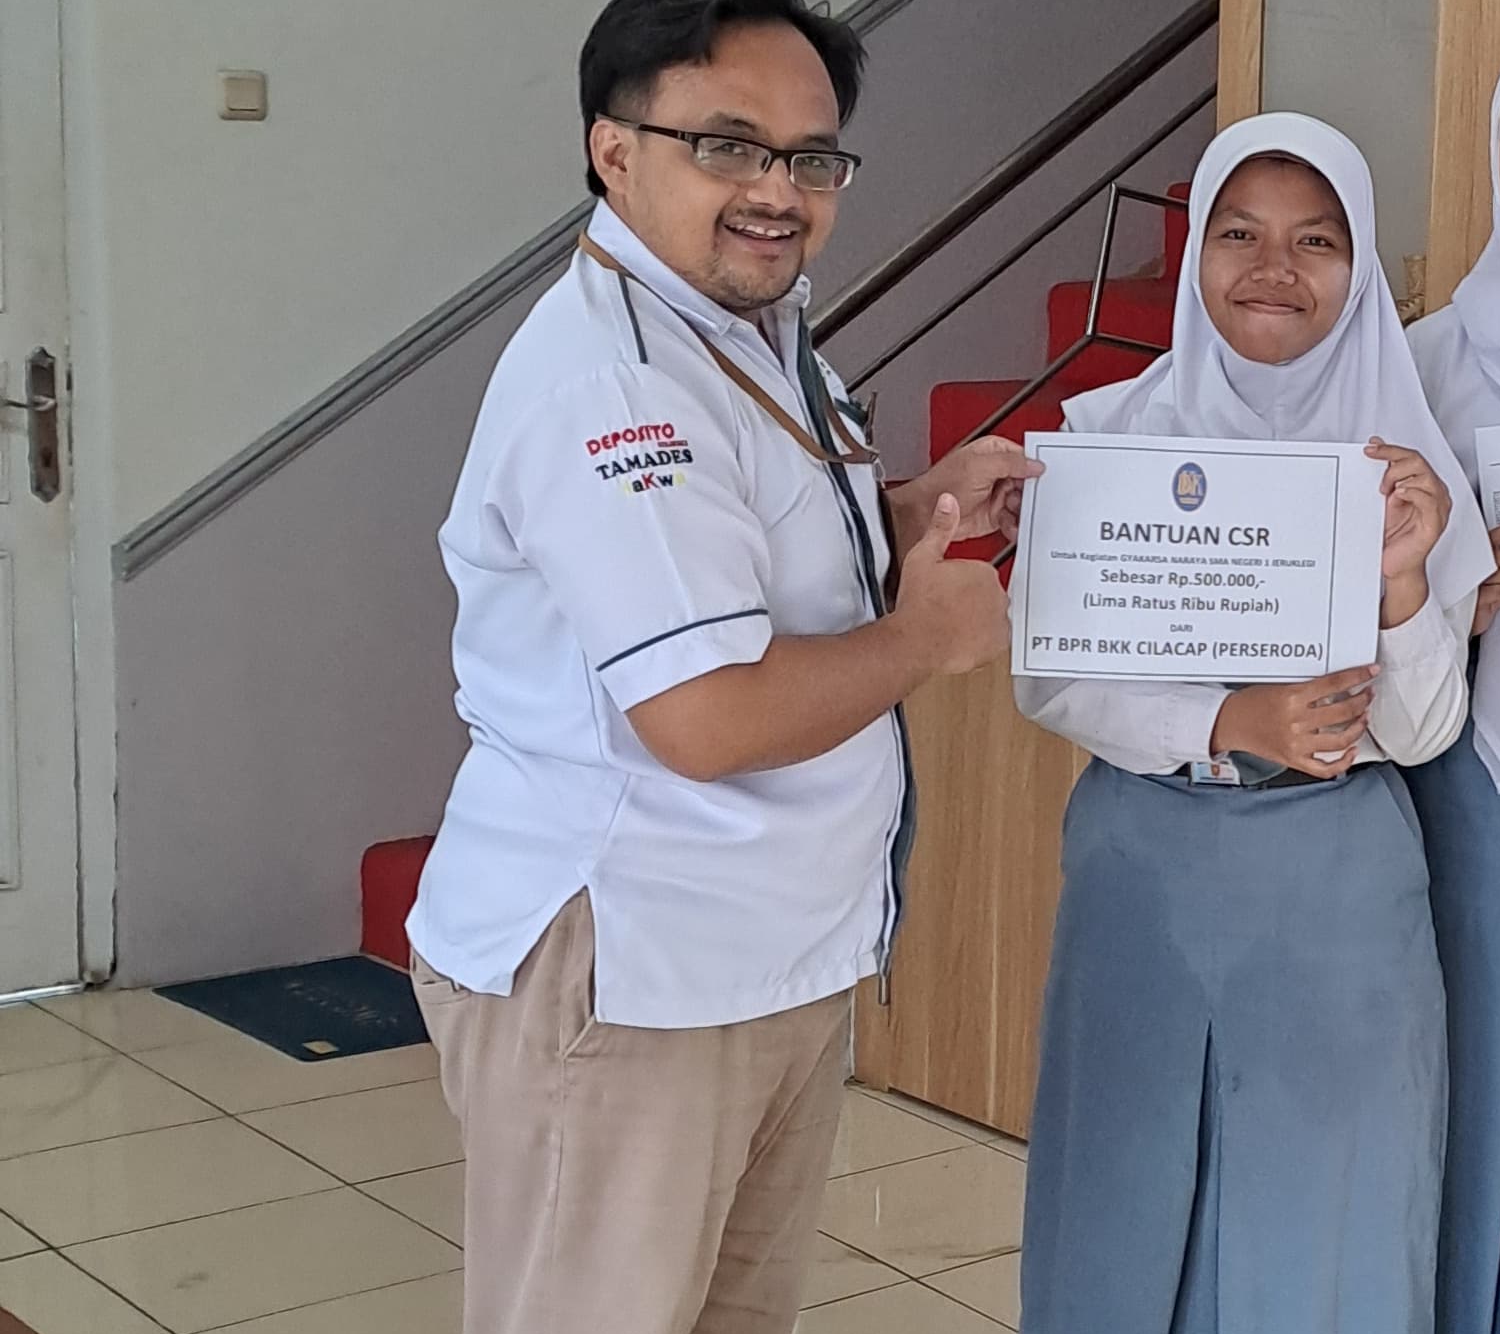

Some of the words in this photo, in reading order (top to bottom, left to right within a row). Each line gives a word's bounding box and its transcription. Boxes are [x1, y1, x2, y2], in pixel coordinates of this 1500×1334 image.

[585, 422, 675, 457] DEPOSITO
[594, 448, 694, 481] TAMADES
[1100, 521, 1220, 546] BANTUAN
[1228, 526, 1270, 547] CSR
[1050, 551, 1077, 559] Untuk
[1080, 552, 1118, 562] Kegiatan
[1209, 557, 1229, 565] SMA
[1231, 558, 1262, 566] NEGERI
[1100, 569, 1164, 585] Sebesar
[1168, 572, 1266, 589] Rp.500.000,-
[1083, 592, 1127, 609] (Lima
[1132, 595, 1176, 610] Ratus
[1181, 597, 1215, 611] Ribu
[1220, 598, 1280, 615] Rupiah)
[1170, 624, 1193, 633] DARI
[1032, 636, 1053, 651] PT
[1058, 637, 1092, 653] BPR
[1097, 639, 1131, 654] BKK
[1136, 641, 1207, 656] CILACAP
[1212, 641, 1324, 661] (PERSERODA)
